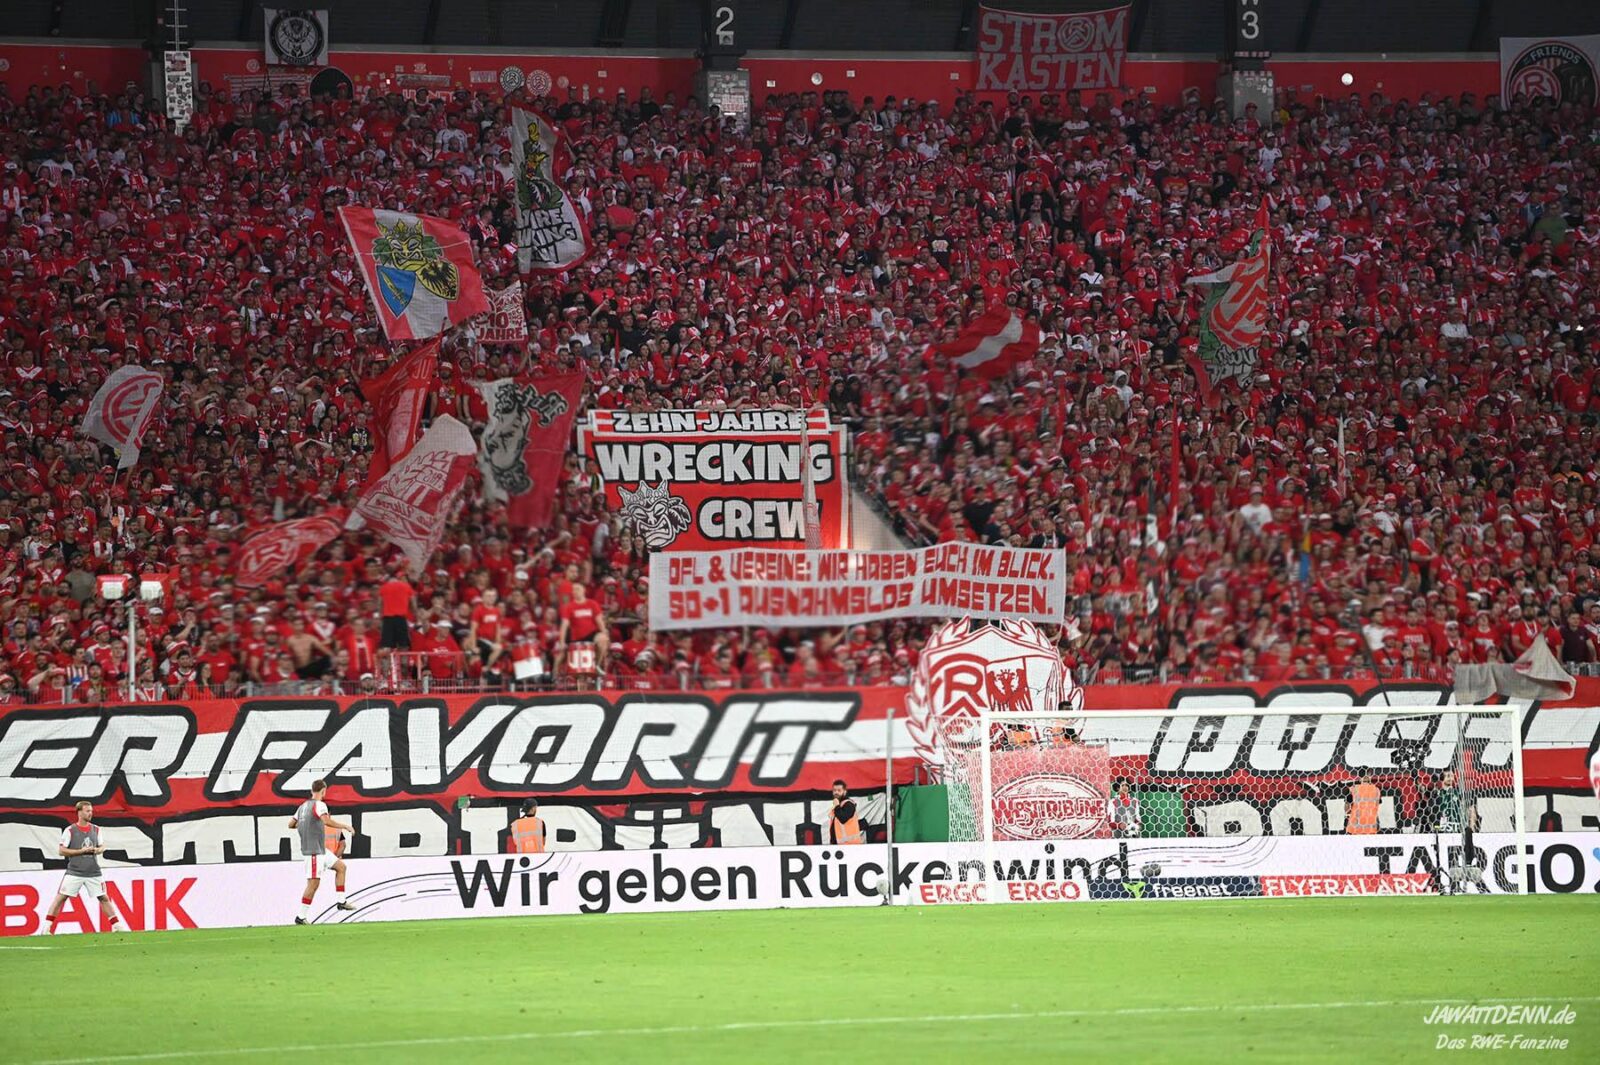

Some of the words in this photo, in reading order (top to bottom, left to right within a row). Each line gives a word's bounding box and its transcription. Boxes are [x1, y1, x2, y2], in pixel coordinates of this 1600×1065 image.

[716, 6, 734, 35] 2
[1241, 10, 1260, 40] 3
[976, 52, 1126, 91] KASTEN
[1529, 46, 1582, 65] FRIENDS
[477, 328, 523, 341] JAHRE
[612, 411, 696, 433] ZEHN
[703, 411, 808, 432] JAHRE
[593, 441, 834, 484] WRECKING
[698, 498, 822, 540] CREW
[669, 557, 704, 586] DFL
[708, 555, 727, 584] &
[818, 552, 849, 582] WIR
[855, 552, 917, 581] HABEN
[923, 544, 970, 574] EUCH
[972, 548, 996, 577] IM
[997, 550, 1055, 580] BLICK.
[738, 582, 914, 617] AUSNAHMSLOS
[920, 577, 1054, 615] UMSETZEN.
[208, 696, 858, 797] FAVORIT
[450, 857, 559, 909] Wir
[578, 853, 757, 914] geben
[780, 842, 1128, 899] Rückenwind
[1007, 881, 1081, 901] ERGO
[1153, 883, 1232, 899] freenet
[1264, 876, 1433, 897] FLYERALARM
[0, 878, 199, 937] BANK
